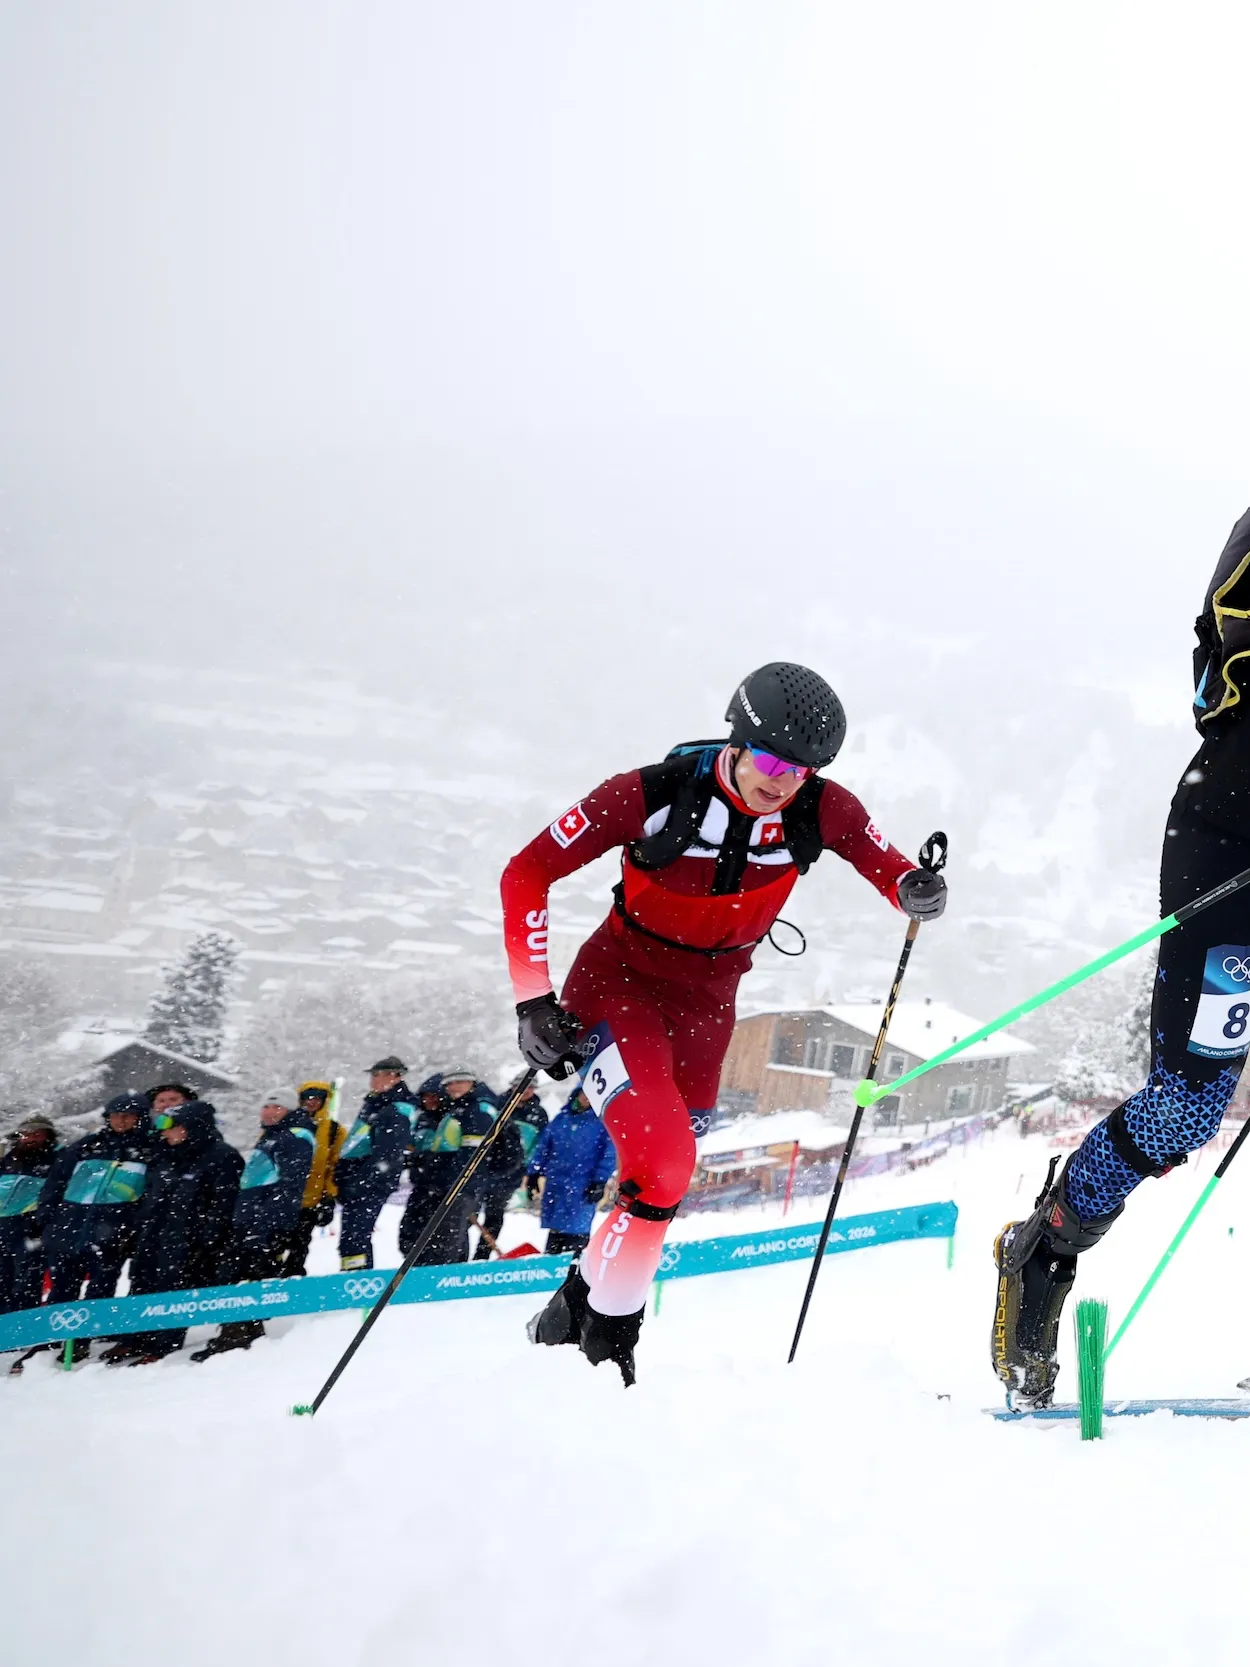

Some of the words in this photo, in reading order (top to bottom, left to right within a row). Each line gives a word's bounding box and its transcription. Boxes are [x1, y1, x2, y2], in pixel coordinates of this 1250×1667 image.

[738, 684, 762, 727] TRAB
[525, 909, 548, 963] SUI
[1222, 1002, 1250, 1039] 8
[1196, 1047, 1223, 1056] MILANO
[591, 1068, 607, 1095] 3
[598, 1211, 633, 1281] SUI
[730, 1240, 786, 1259] MILANO
[787, 1231, 847, 1249] CORTNA
[847, 1225, 877, 1240] 2026
[436, 1273, 492, 1288] MILANO
[493, 1268, 553, 1284] CORTINA
[554, 1267, 570, 1279] 20
[140, 1302, 197, 1317] MILANO
[197, 1295, 259, 1312] CORTINA
[260, 1292, 289, 1305] 2026
[995, 1276, 1010, 1381] SPORTIVA
